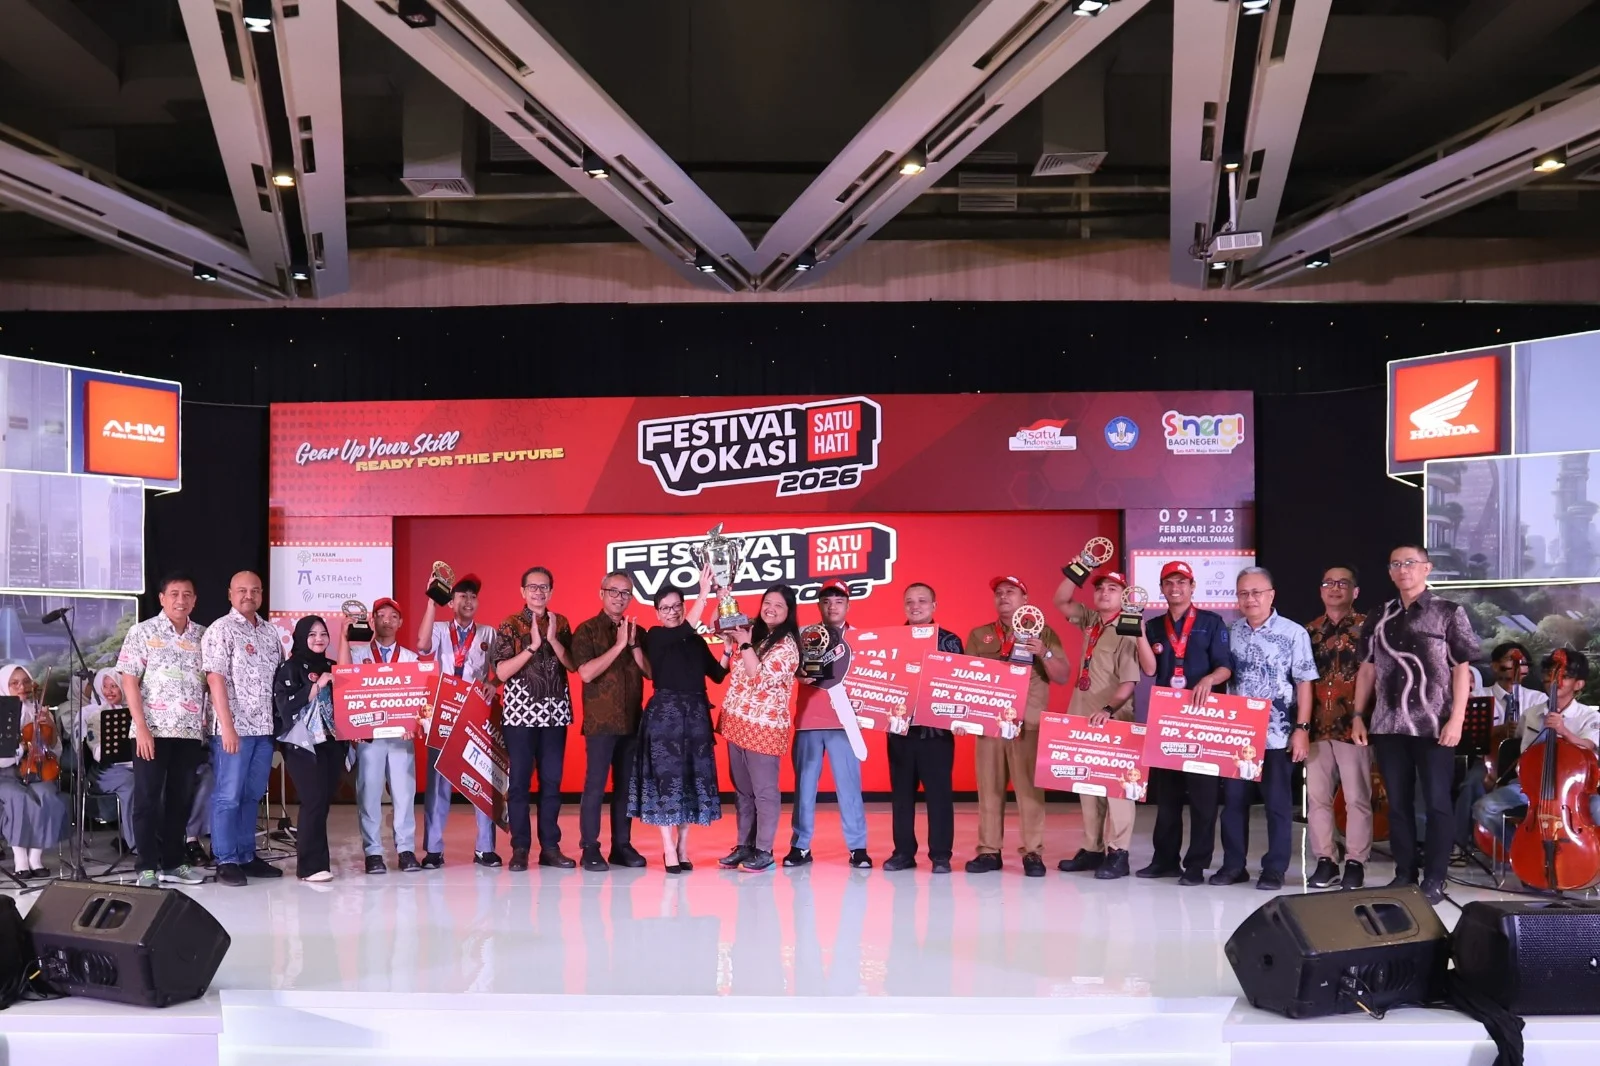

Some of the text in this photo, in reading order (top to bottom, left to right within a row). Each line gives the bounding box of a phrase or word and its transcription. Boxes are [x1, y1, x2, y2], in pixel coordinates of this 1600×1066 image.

[103, 419, 166, 437] AHM
[646, 410, 796, 451] FESTIVAL
[814, 410, 852, 433] SATU
[1410, 424, 1480, 440] HONDA
[296, 430, 460, 466] Gear Up Your Skill
[814, 432, 849, 454] HATI
[356, 448, 565, 472] READY FOR THE FUTURE
[660, 438, 796, 482] VOKASI
[780, 467, 859, 493] 2026
[816, 534, 862, 554] SATU
[817, 553, 857, 572] HATI
[633, 558, 795, 595] VOASI
[892, 648, 898, 660] 1
[361, 676, 411, 686] JUARA 3
[852, 666, 896, 681] JUARA 1
[951, 668, 1000, 683] JUARA 1
[930, 681, 958, 689] BANTUAN
[348, 698, 427, 710] RP. 6.000.000
[850, 688, 905, 705] 10.000.000
[932, 689, 1012, 708] RP. 8.000.000
[441, 711, 452, 722] RP.
[1180, 705, 1237, 720] JUARA 3
[1158, 719, 1189, 727] BANTUAN
[464, 726, 488, 752] BEASISWA
[1068, 730, 1121, 745] JUARA 2
[1161, 727, 1181, 738] RP.
[1185, 730, 1251, 747] 4.000.000
[1051, 751, 1135, 769] RP. 6.000.000
